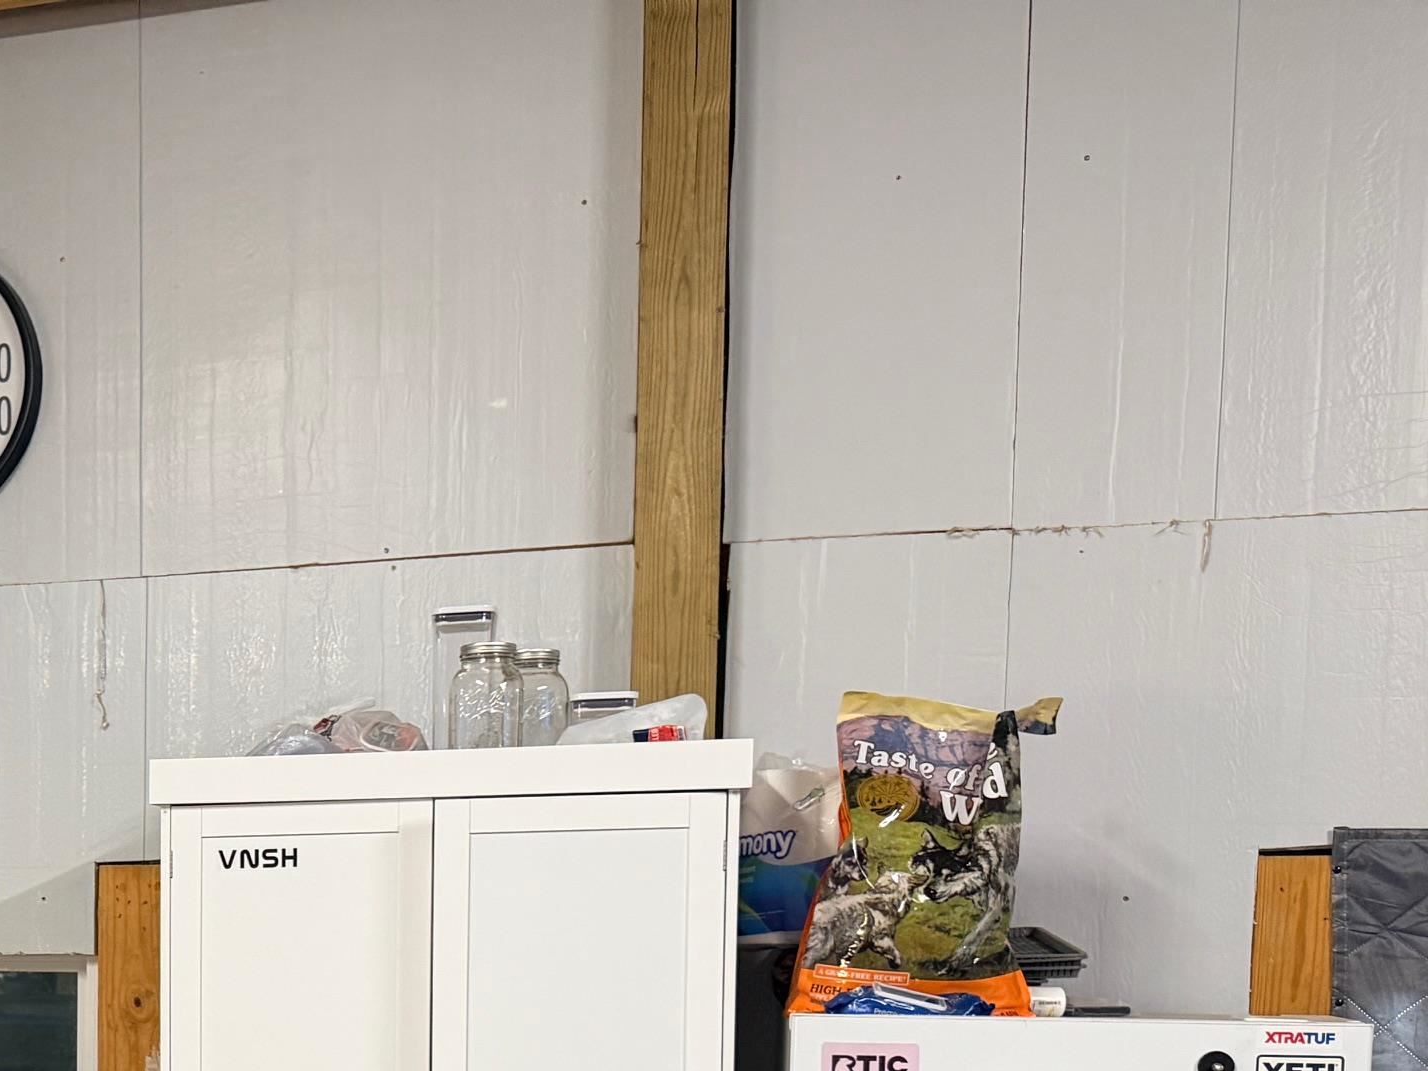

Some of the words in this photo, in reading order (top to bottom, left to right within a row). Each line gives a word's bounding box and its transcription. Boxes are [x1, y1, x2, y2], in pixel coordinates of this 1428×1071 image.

[854, 739, 935, 779] Taste
[946, 764, 982, 790] of
[218, 847, 298, 870] VNSH
[1265, 1031, 1336, 1045] XTRATUF
